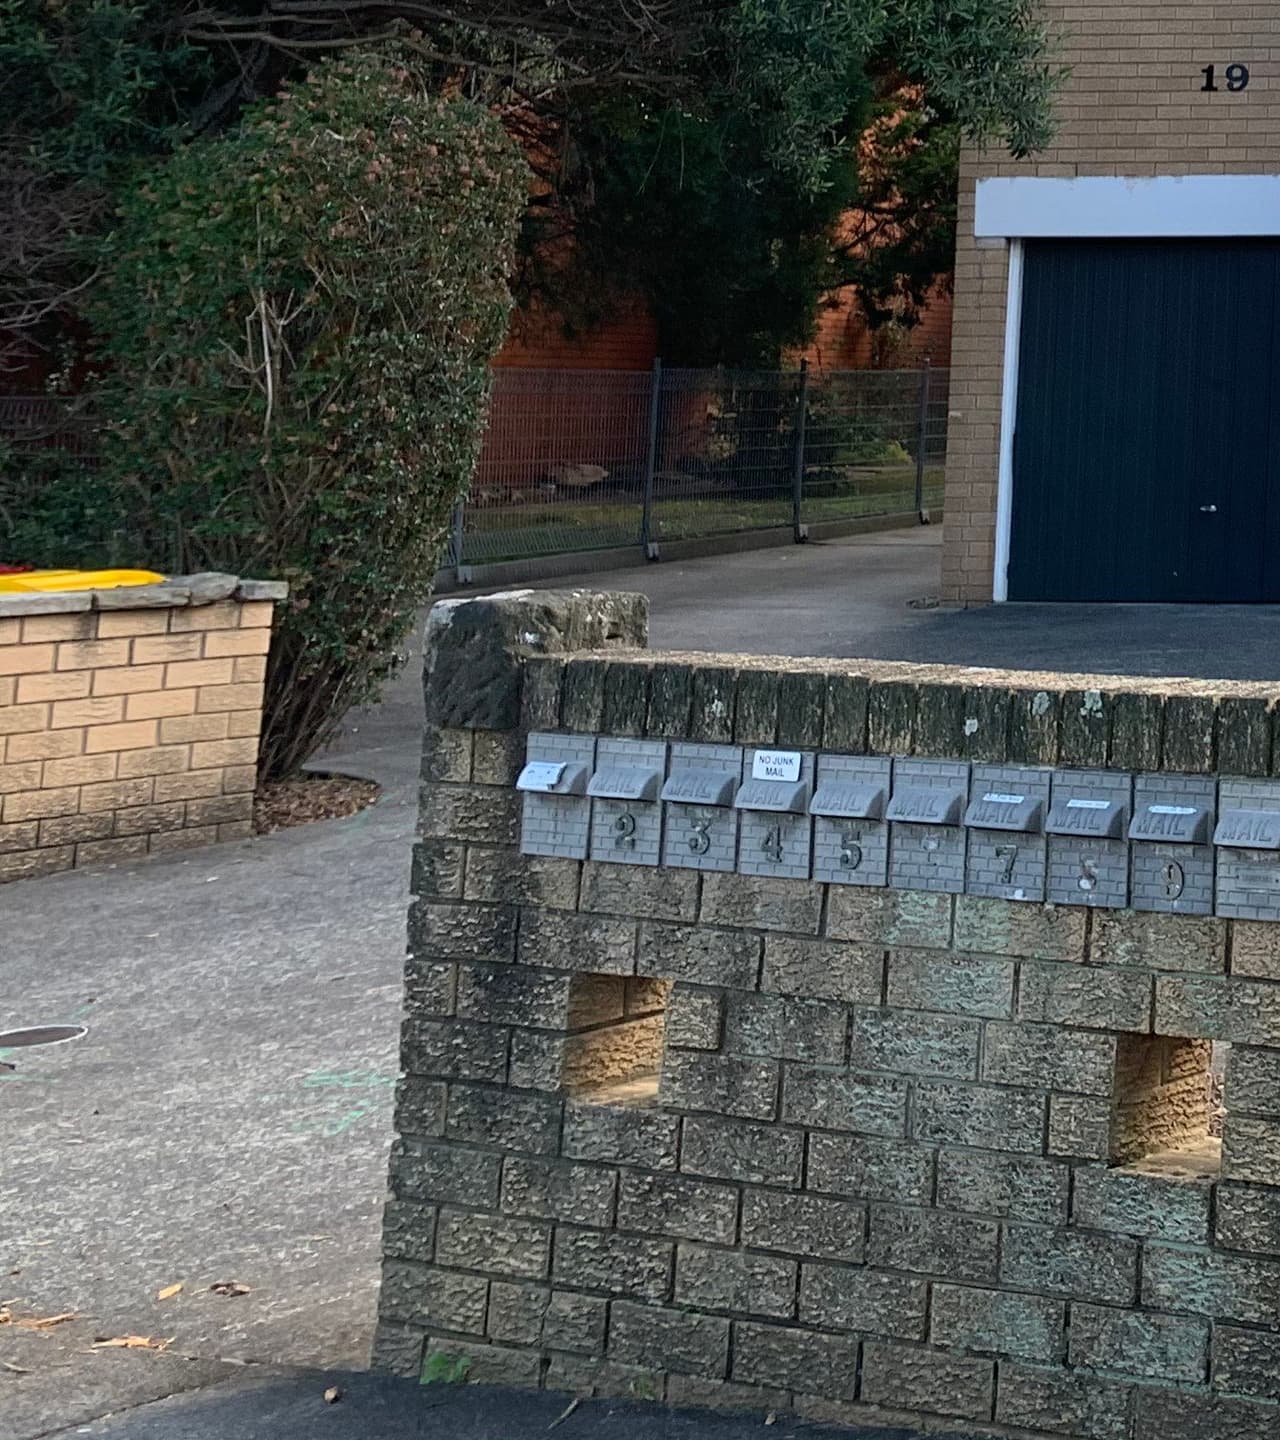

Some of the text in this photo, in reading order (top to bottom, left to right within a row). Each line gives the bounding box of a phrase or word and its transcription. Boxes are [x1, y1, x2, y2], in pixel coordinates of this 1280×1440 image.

[1200, 63, 1249, 92] 19
[759, 755, 794, 766] NO JUNK
[766, 767, 784, 777] MAIL
[973, 803, 1020, 824] MAIL
[1052, 808, 1100, 830] MAIL
[1136, 812, 1186, 836] MAIL
[614, 813, 636, 850] 2
[688, 812, 711, 855] 3
[762, 824, 784, 863] 4
[1221, 818, 1273, 842] MAIL
[840, 831, 863, 870] 5
[995, 845, 1018, 883] 7
[1161, 860, 1185, 901] 9
